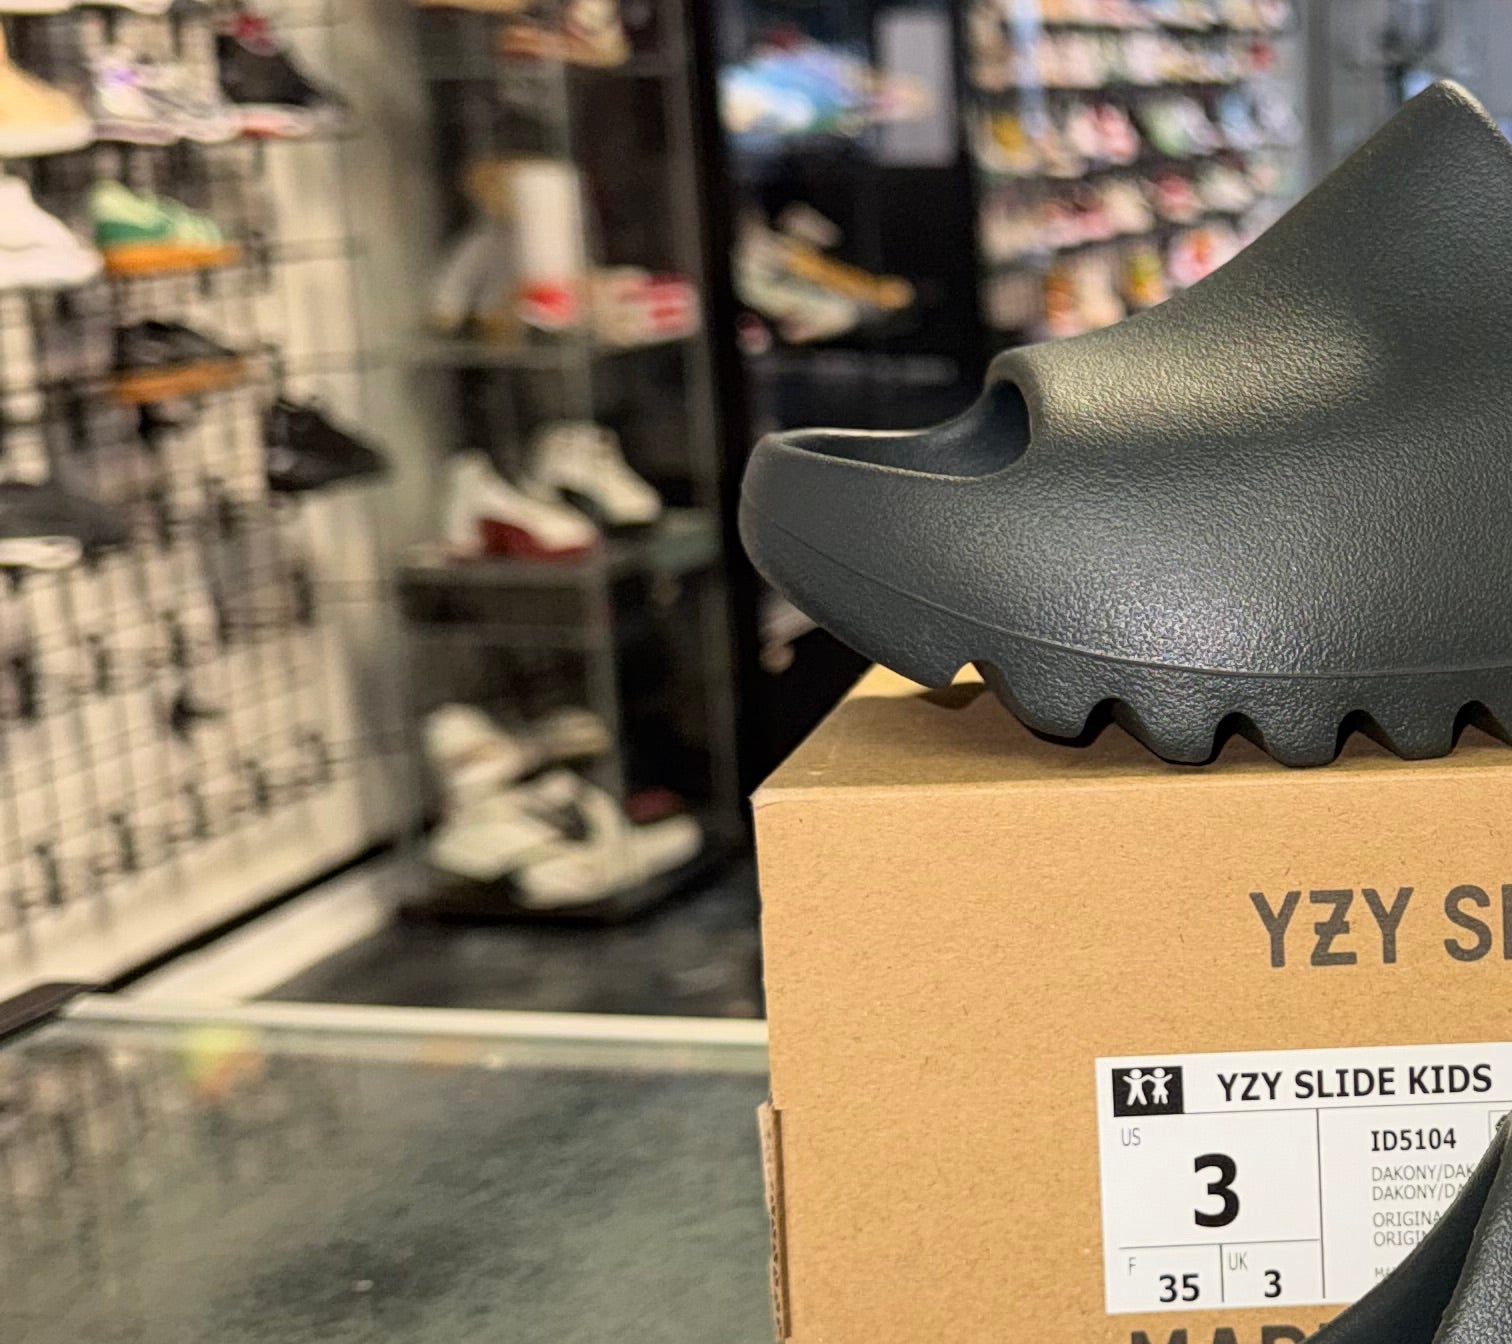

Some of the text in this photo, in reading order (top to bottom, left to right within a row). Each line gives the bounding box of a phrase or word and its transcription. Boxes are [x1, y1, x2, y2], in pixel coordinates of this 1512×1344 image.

[1249, 887, 1414, 968] YZY
[1217, 1063, 1492, 1102] YZY SLIDE KIDS
[1121, 1127, 1141, 1147] US
[1371, 1127, 1457, 1152] ID5104
[1371, 1162, 1477, 1182] DAKONY/DAK
[1193, 1152, 1240, 1228] 3
[1228, 1252, 1248, 1272] UK
[1159, 1272, 1201, 1303] 35
[1263, 1268, 1283, 1298] 3
